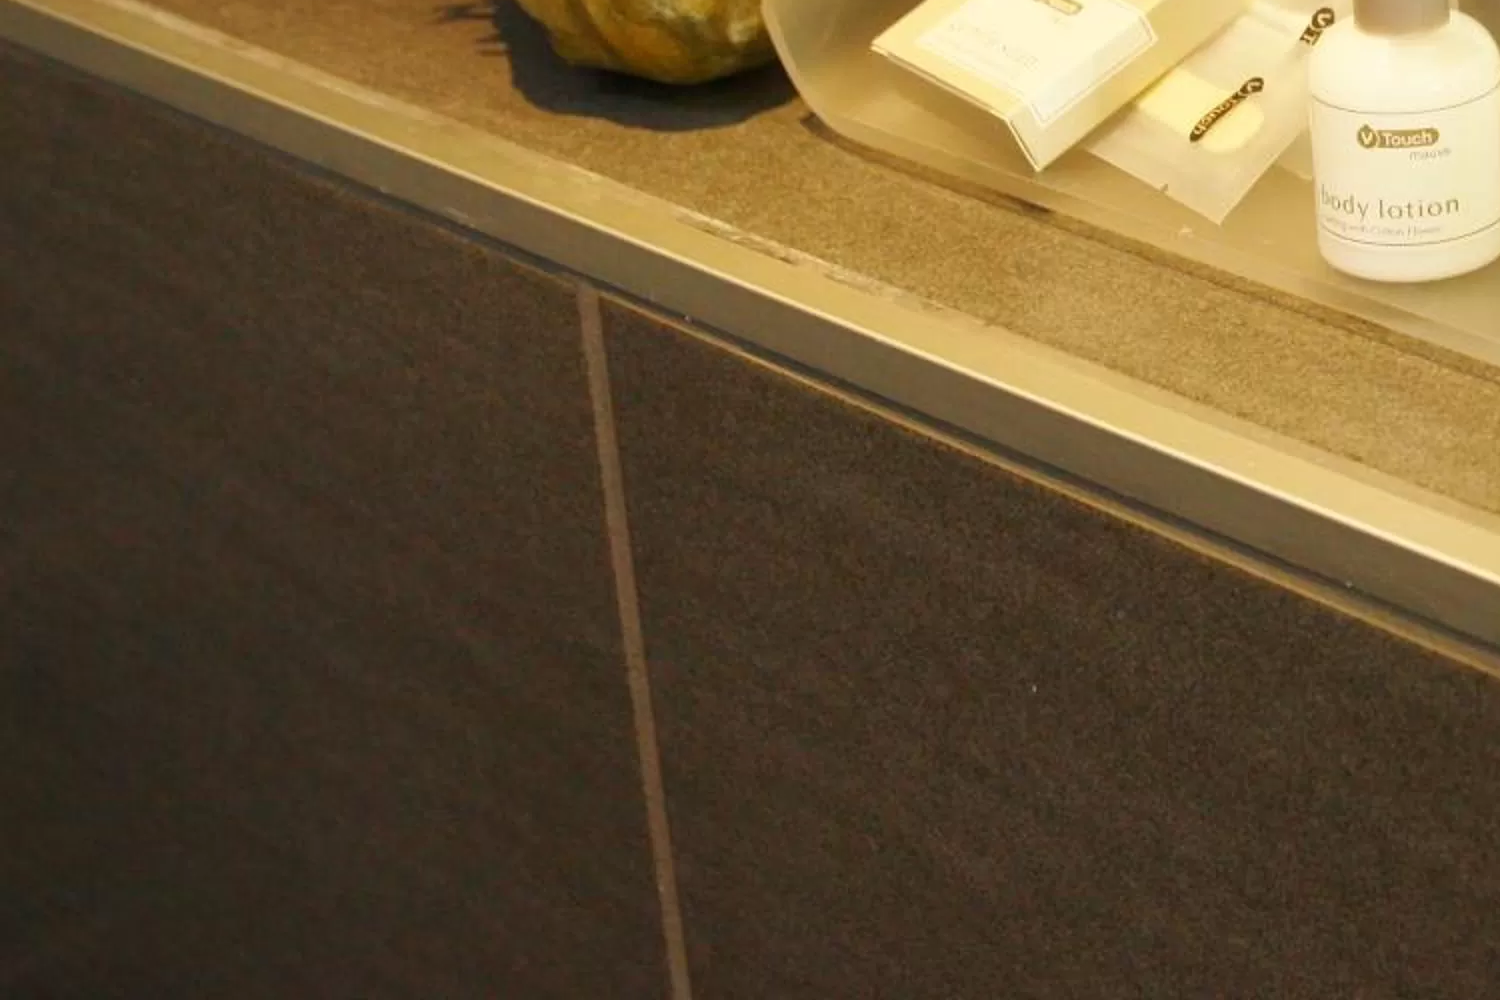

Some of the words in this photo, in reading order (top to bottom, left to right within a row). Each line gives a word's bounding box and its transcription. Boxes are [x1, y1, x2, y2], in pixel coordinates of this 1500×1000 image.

[1359, 129, 1375, 146] V
[1380, 130, 1434, 146] Touch
[1321, 183, 1369, 221] body
[1378, 196, 1460, 220] lotion
